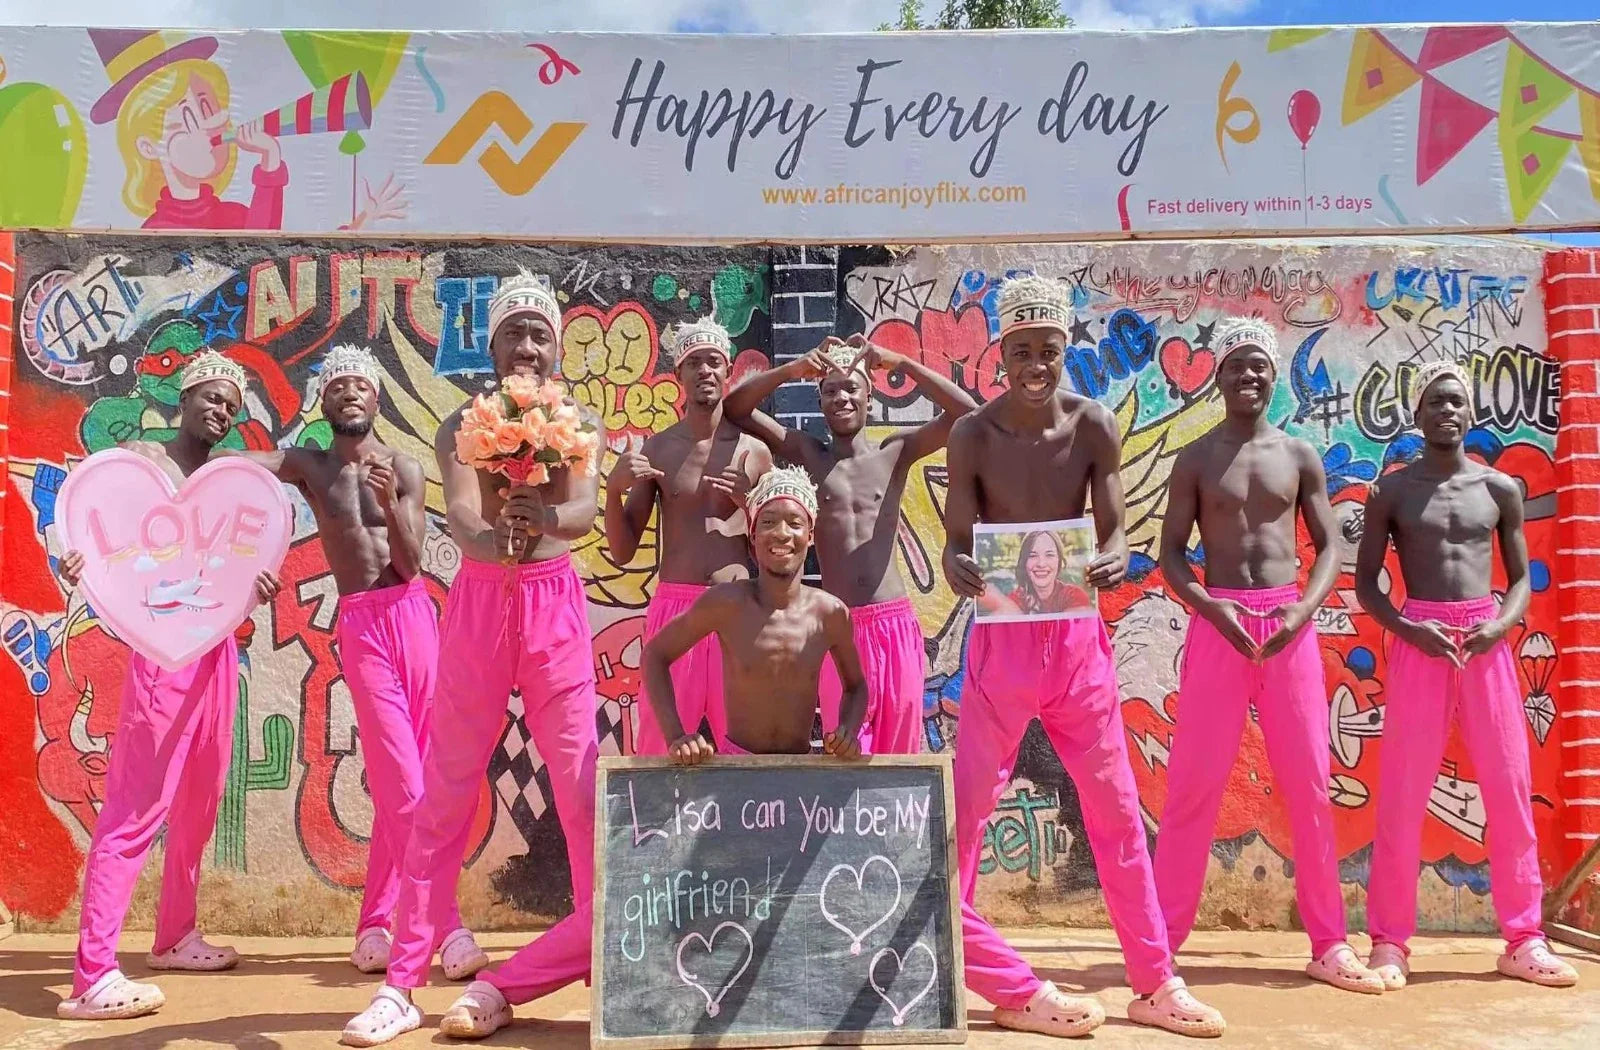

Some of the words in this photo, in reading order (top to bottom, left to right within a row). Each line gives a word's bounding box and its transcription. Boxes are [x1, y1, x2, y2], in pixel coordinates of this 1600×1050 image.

[611, 57, 827, 181] Happy
[843, 57, 1022, 180] Every
[1037, 60, 1170, 177] day
[762, 182, 1027, 209] www.africanjoyflix.com
[1148, 199, 1182, 214] Fast
[1187, 197, 1249, 216] delivery
[1254, 197, 1301, 212] within
[1307, 195, 1331, 211] 1-3
[1335, 195, 1373, 213] days
[86, 502, 269, 558] LOVE
[628, 780, 722, 847] Lisa
[741, 799, 787, 831] can
[855, 787, 888, 837] be
[620, 855, 774, 963] girlfriend
